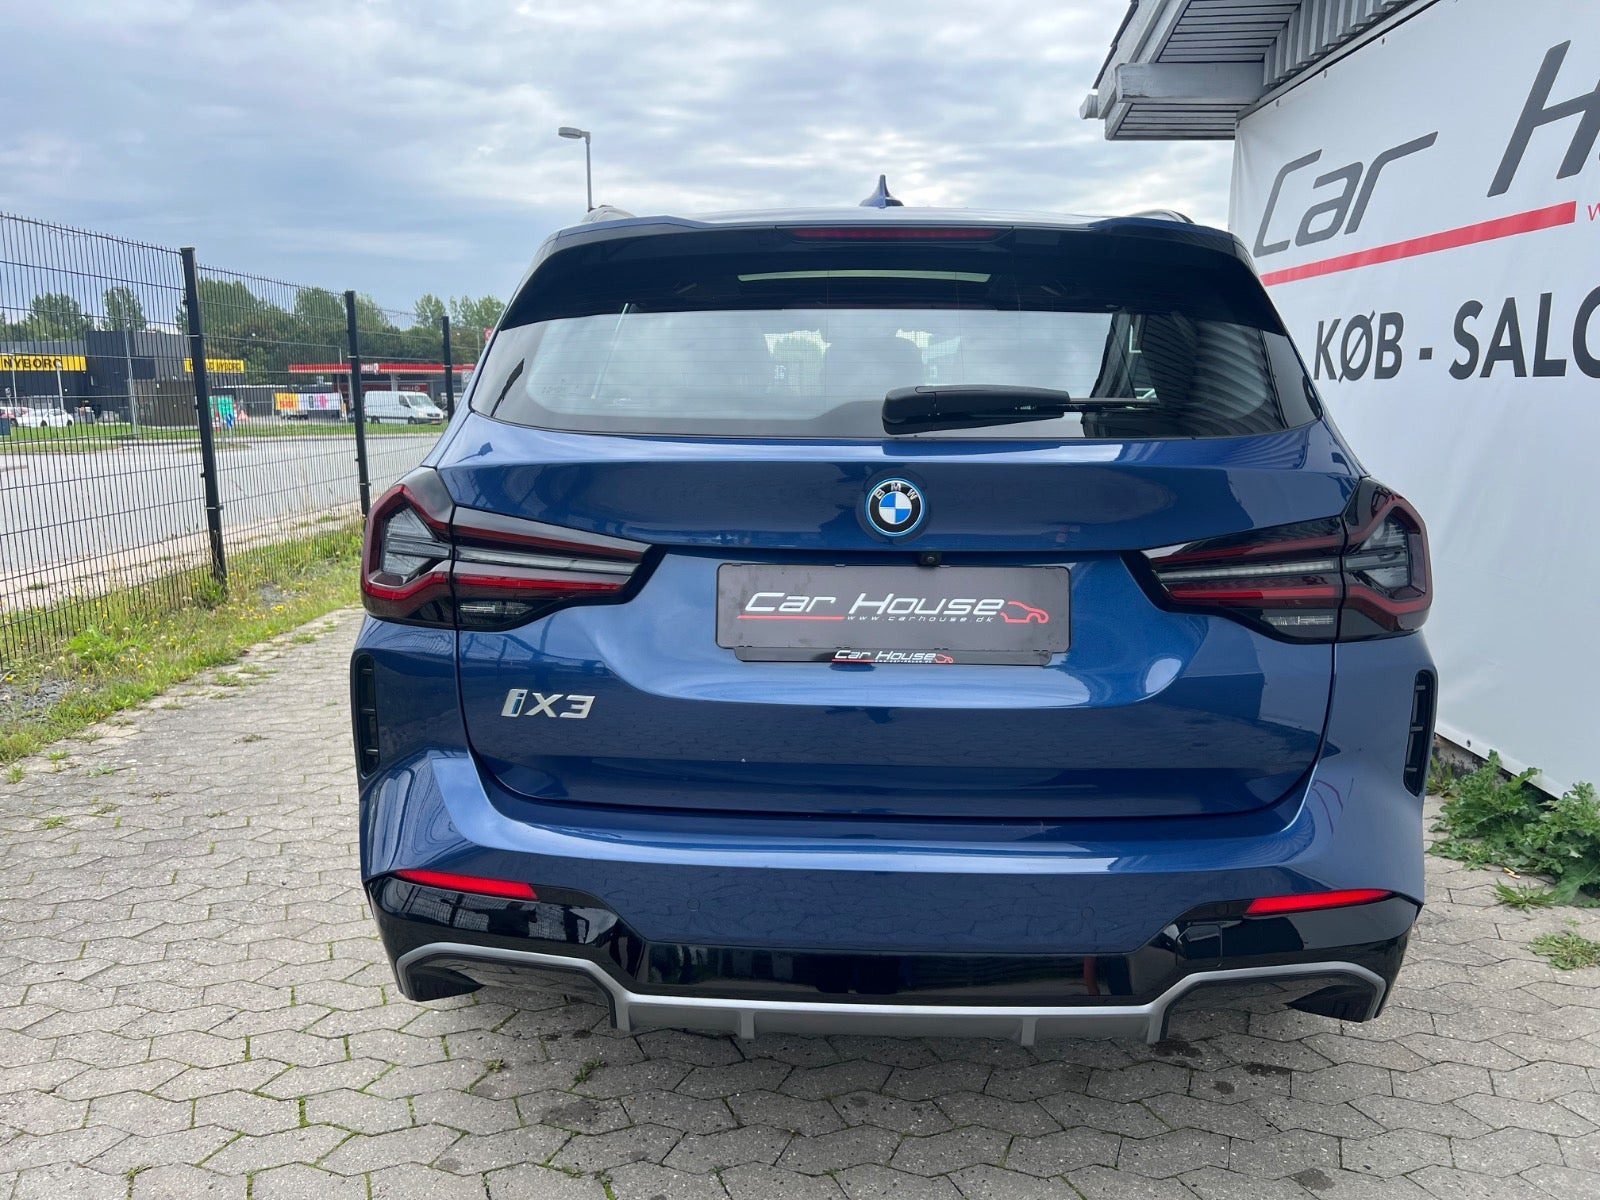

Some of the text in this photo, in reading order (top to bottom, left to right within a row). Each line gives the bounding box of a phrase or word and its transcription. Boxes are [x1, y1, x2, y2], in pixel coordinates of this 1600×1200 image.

[1252, 132, 1439, 258] Car
[1313, 310, 1405, 384] KØB
[3, 358, 63, 369] NYBORG
[874, 482, 918, 501] BMW
[744, 592, 1005, 616] Car House
[847, 614, 994, 624] www.carhouse.dk
[834, 649, 936, 661] Car House
[501, 688, 596, 719] iX3
